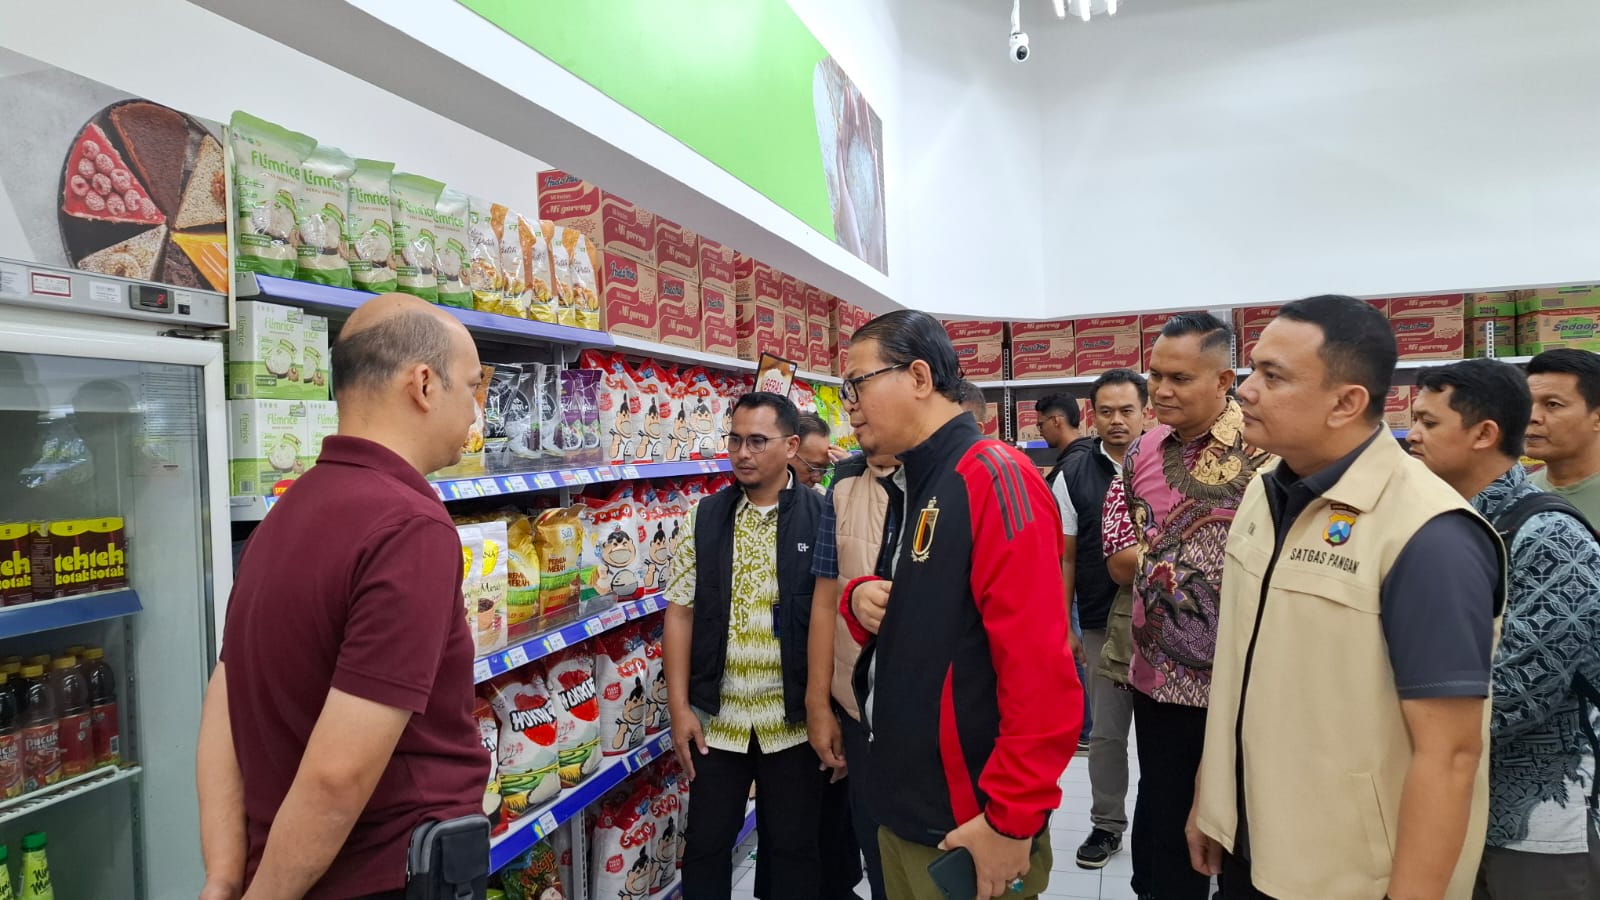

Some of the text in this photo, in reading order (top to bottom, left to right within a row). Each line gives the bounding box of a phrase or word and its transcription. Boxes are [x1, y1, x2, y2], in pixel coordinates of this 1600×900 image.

[561, 203, 592, 215] goreng
[0, 551, 31, 576] eh
[54, 547, 89, 572] teh
[89, 543, 124, 568] teh
[1290, 547, 1360, 574] SATGAS PANGAN
[0, 574, 32, 590] otak
[55, 569, 90, 586] kotak
[90, 565, 125, 581] kotak
